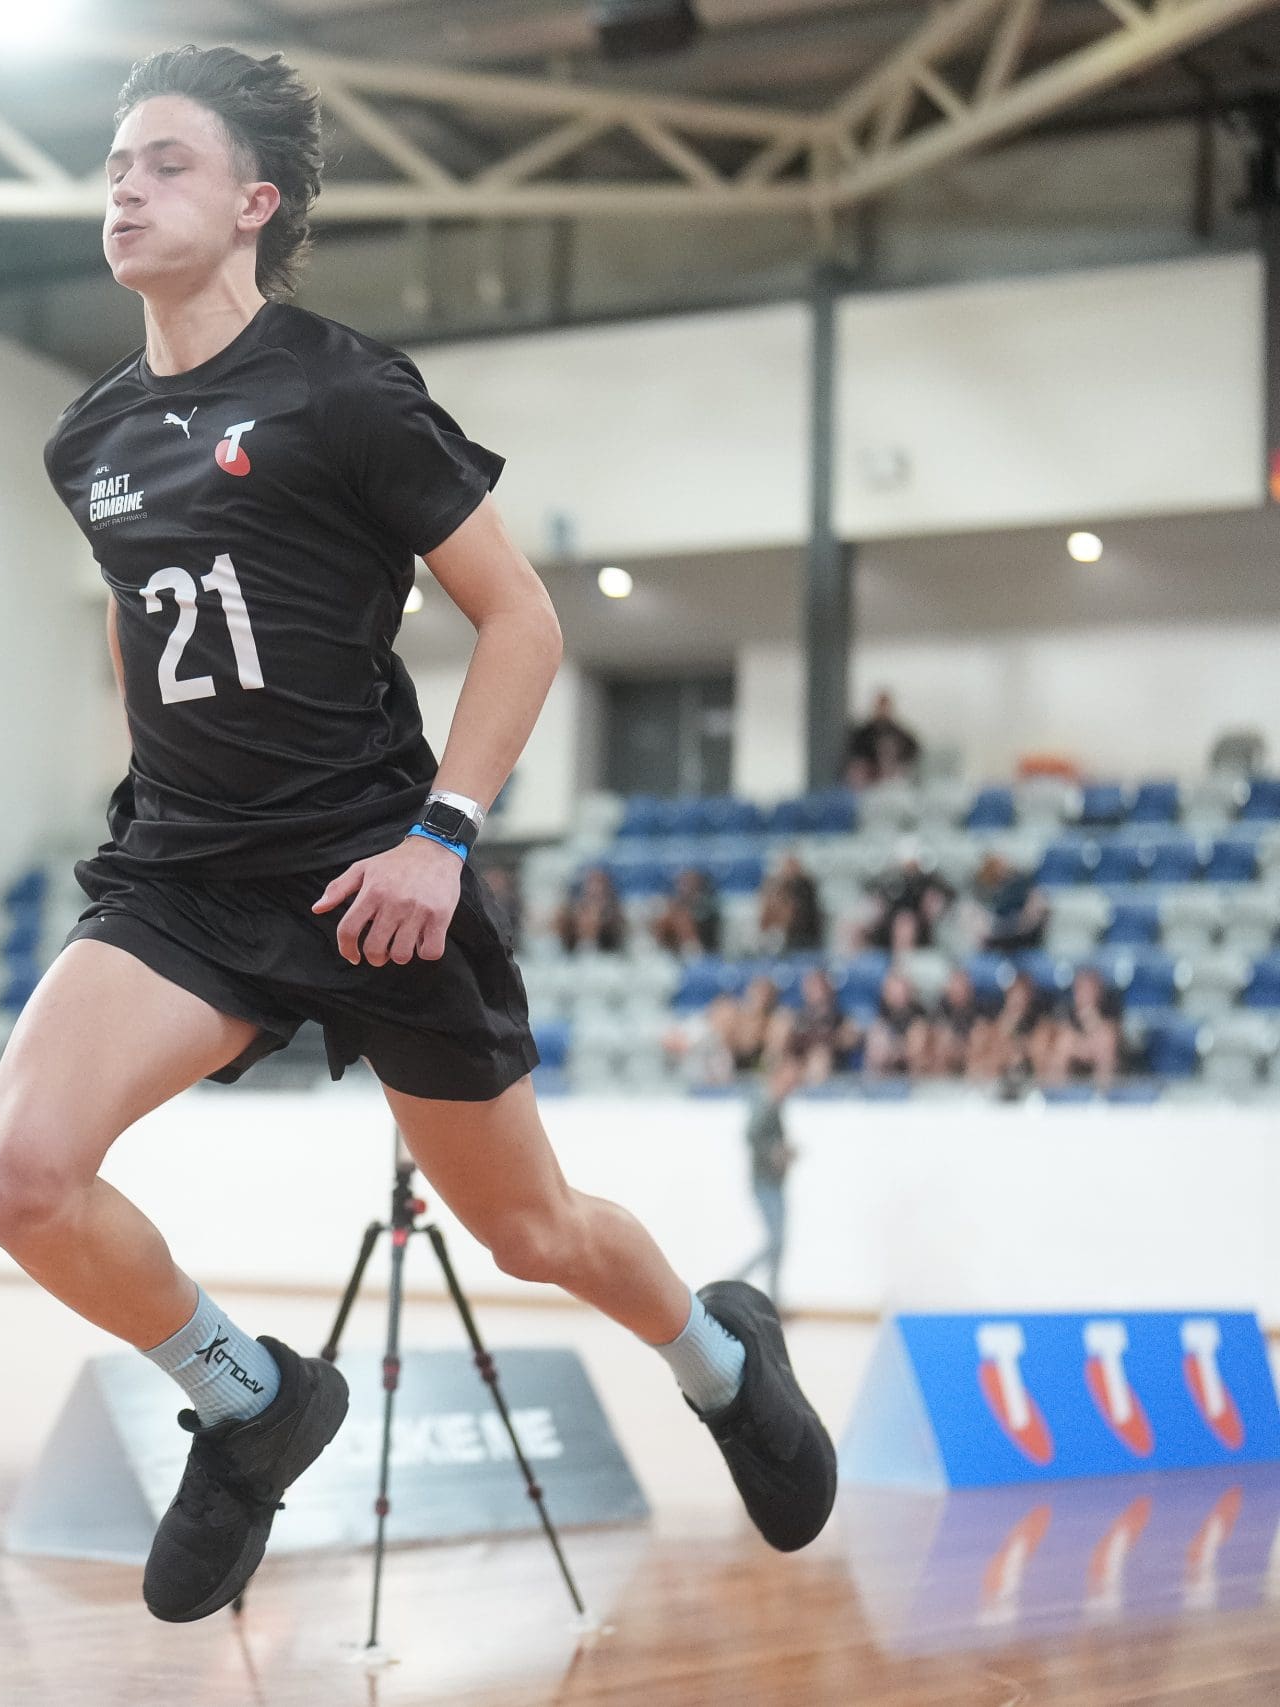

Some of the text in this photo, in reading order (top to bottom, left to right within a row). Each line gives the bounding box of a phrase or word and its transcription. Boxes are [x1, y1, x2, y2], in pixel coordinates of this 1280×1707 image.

[224, 420, 256, 463] T
[95, 465, 110, 475] AFL
[90, 474, 130, 501] DRAFT
[90, 491, 144, 522] COMBINE
[139, 553, 265, 704] 21
